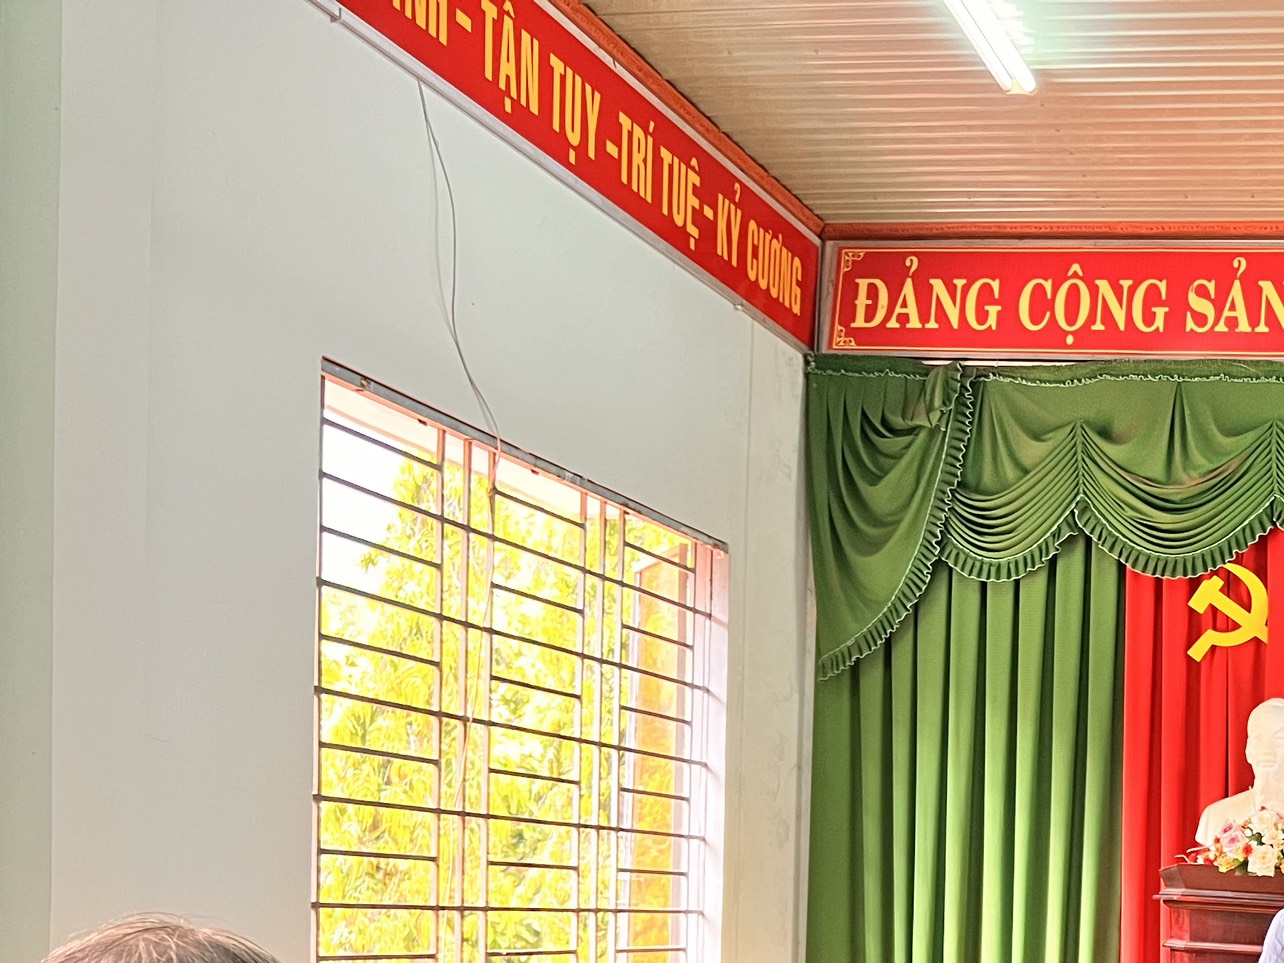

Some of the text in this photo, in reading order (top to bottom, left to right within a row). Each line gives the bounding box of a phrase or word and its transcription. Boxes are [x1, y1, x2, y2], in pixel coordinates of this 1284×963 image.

[481, 0, 539, 116] TẬN
[549, 53, 601, 165] TỤY
[660, 146, 700, 250] TUỆ
[717, 182, 742, 267] KỶ
[852, 257, 1002, 332] ĐẢNG
[1018, 263, 1169, 346] CỘNG
